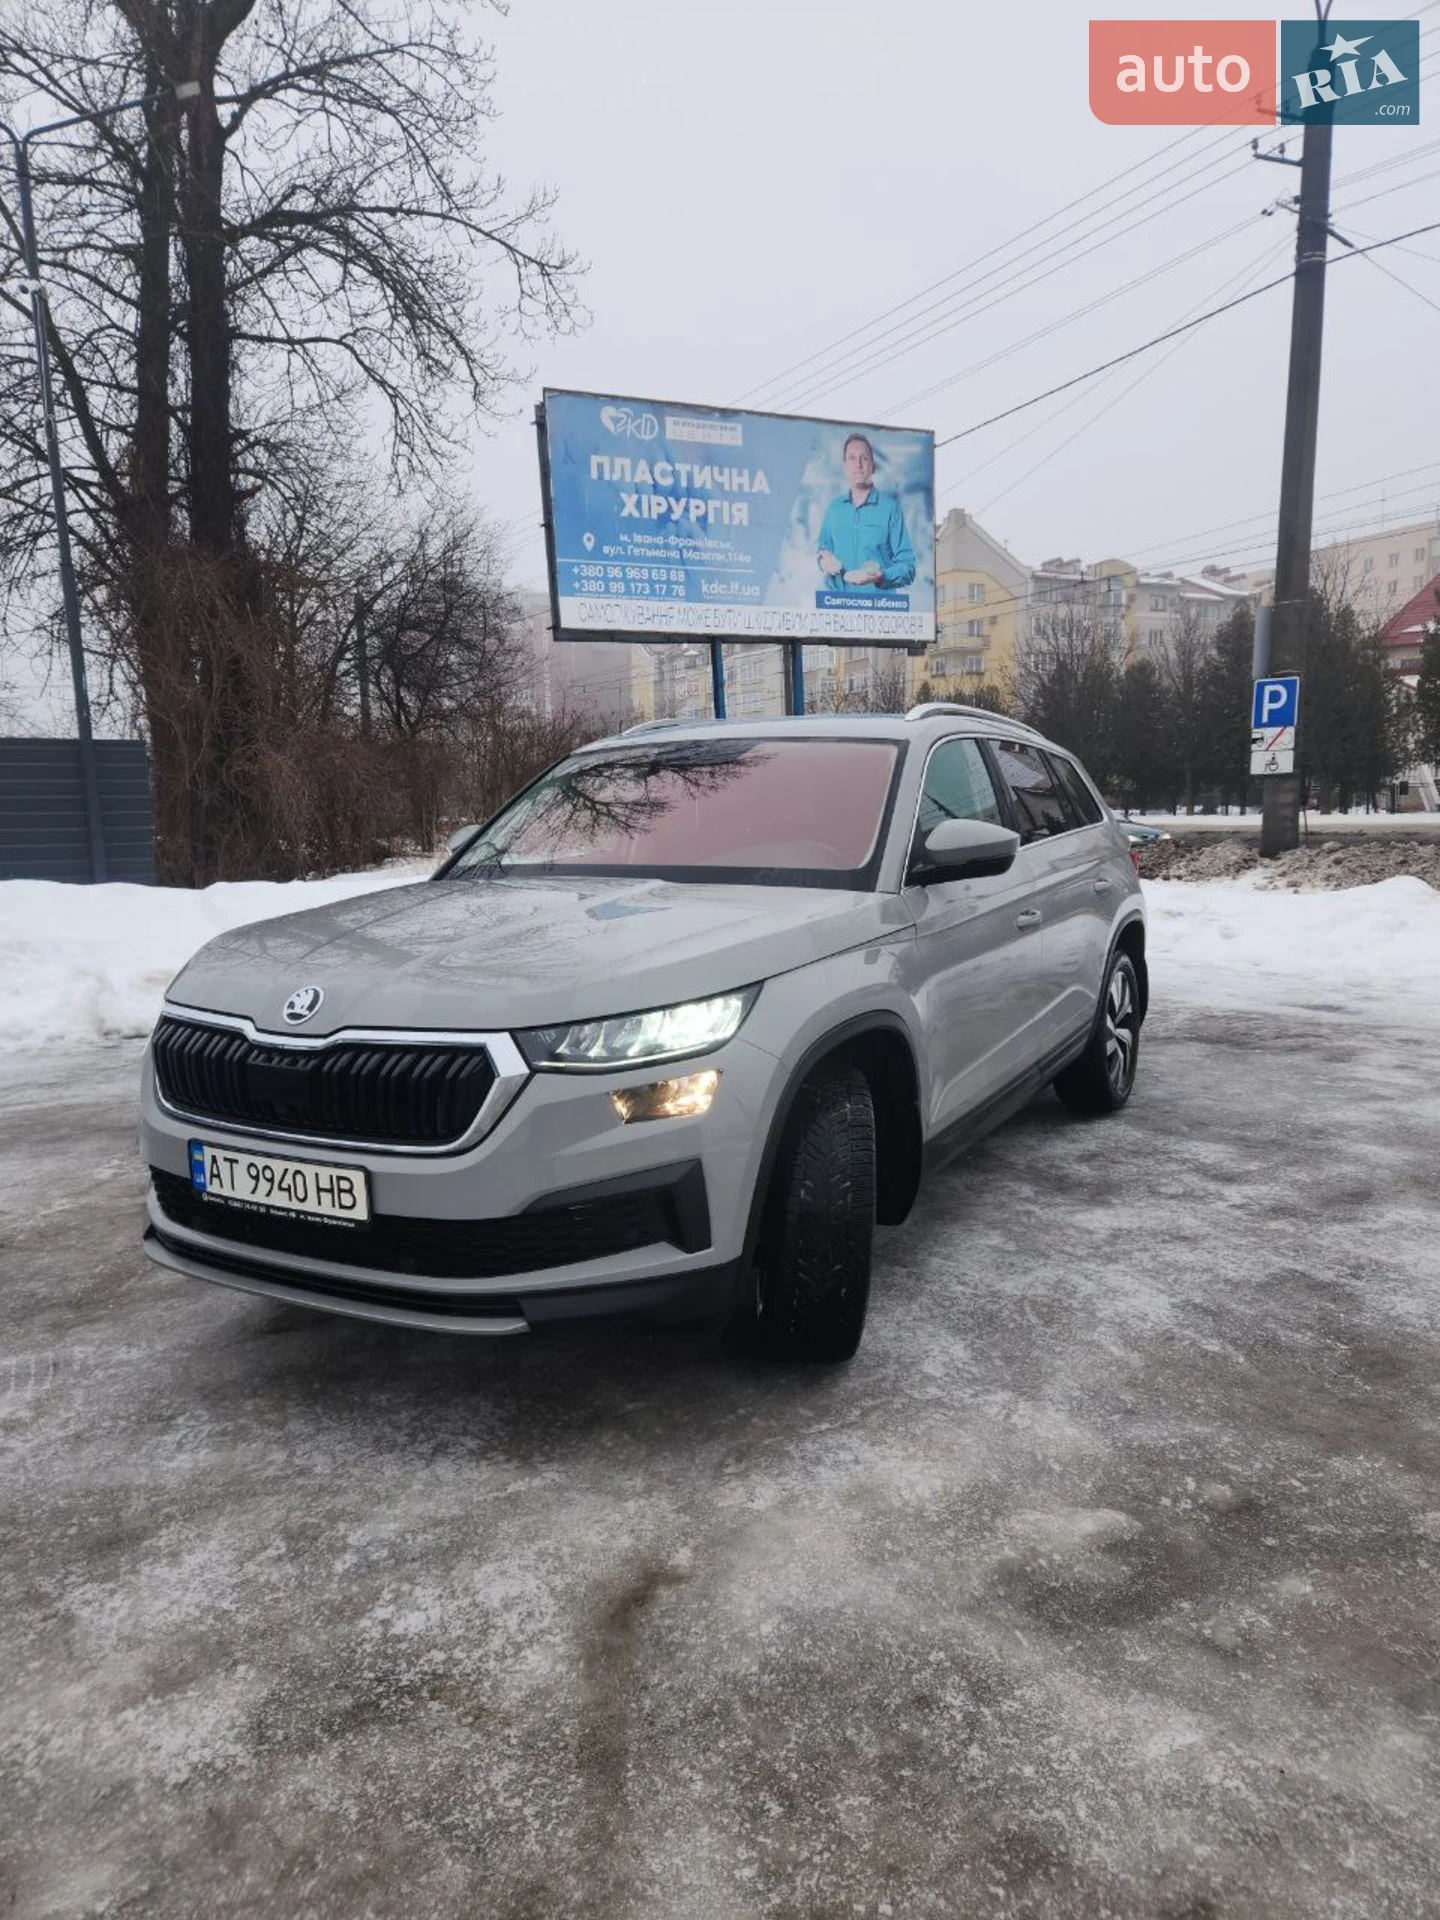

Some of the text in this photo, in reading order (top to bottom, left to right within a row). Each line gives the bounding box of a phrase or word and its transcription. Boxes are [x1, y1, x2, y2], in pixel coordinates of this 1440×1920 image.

[590, 455, 771, 495] ПЛАСТИЧНА
[619, 491, 749, 527] ХІРУРГІЯ
[572, 564, 604, 578] +380
[606, 566, 624, 579] 96
[572, 579, 686, 597] +380 99 173 17 76
[1261, 684, 1288, 724] P
[209, 1154, 357, 1211] AT 9940 HB
